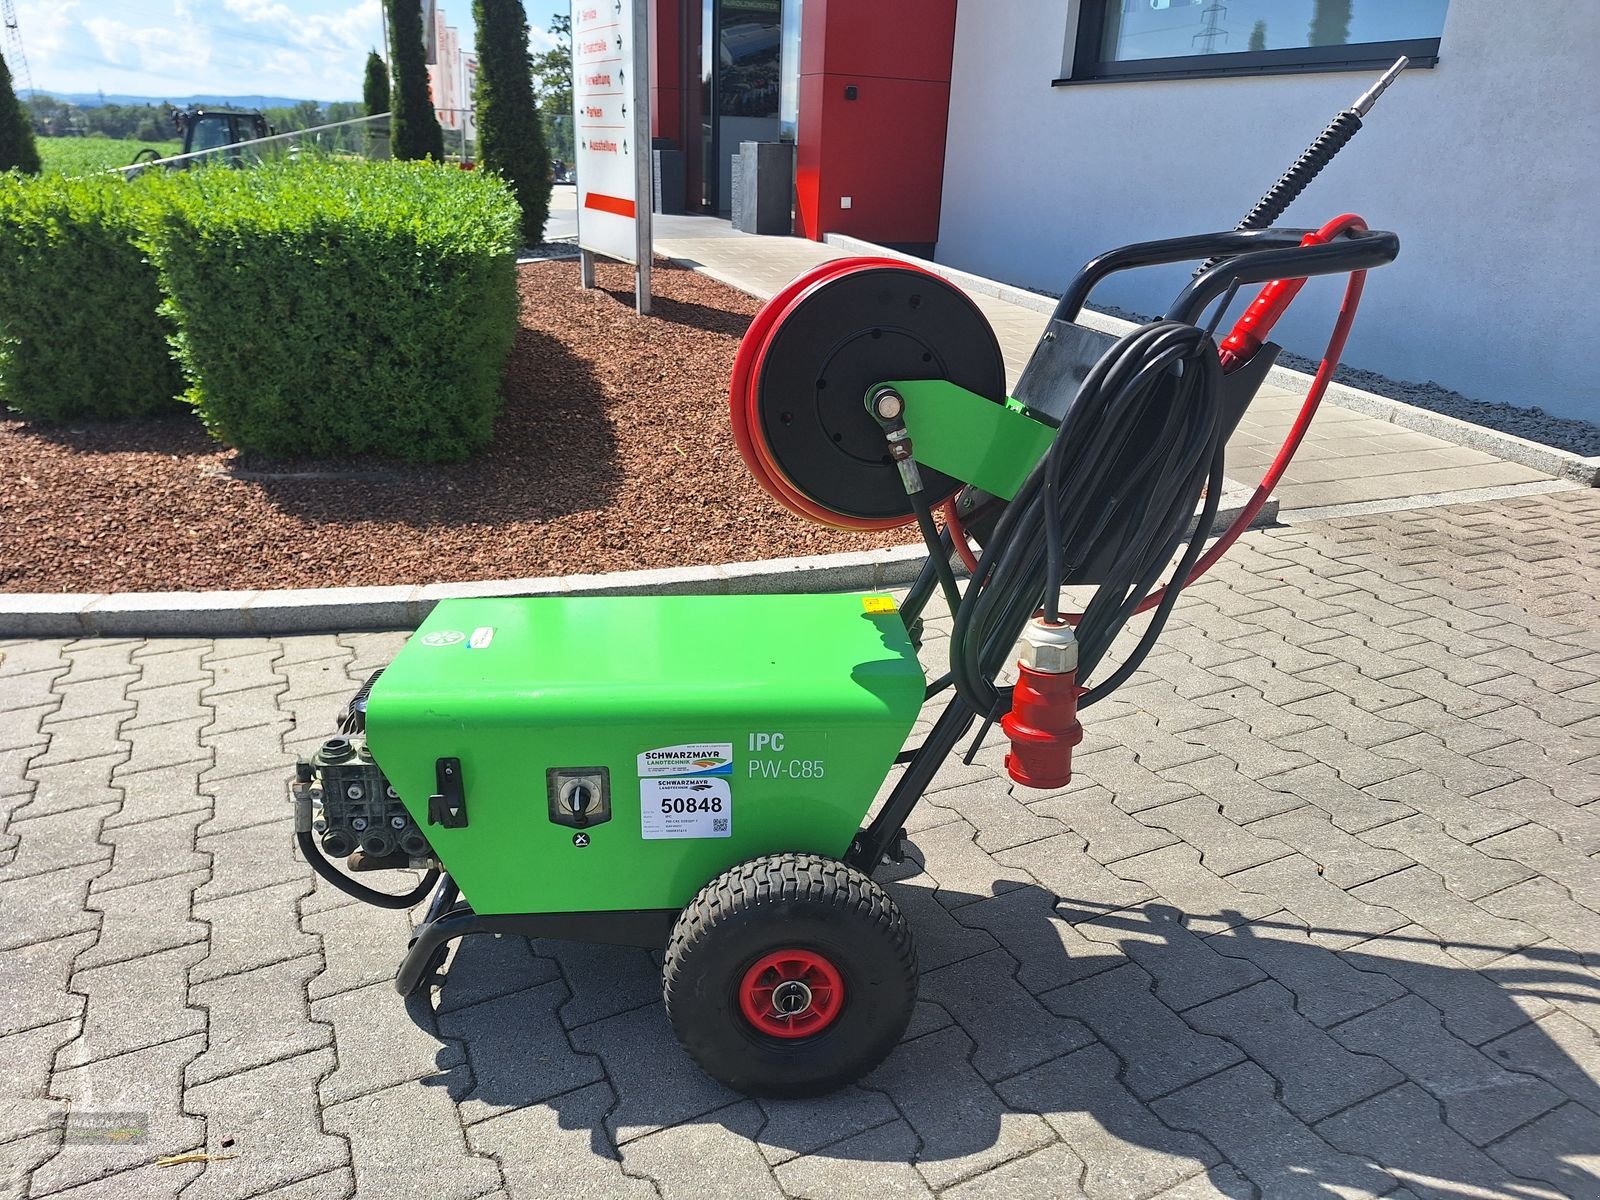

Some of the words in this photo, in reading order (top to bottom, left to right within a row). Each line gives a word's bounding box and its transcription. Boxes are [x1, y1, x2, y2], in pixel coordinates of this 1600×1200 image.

[586, 106, 603, 118] Parken
[589, 139, 617, 155] Ausstellung
[749, 732, 785, 752] IPC
[645, 751, 720, 760] SCHWARZMAYR
[748, 759, 824, 778] PW-C85
[661, 797, 722, 813] 50848
